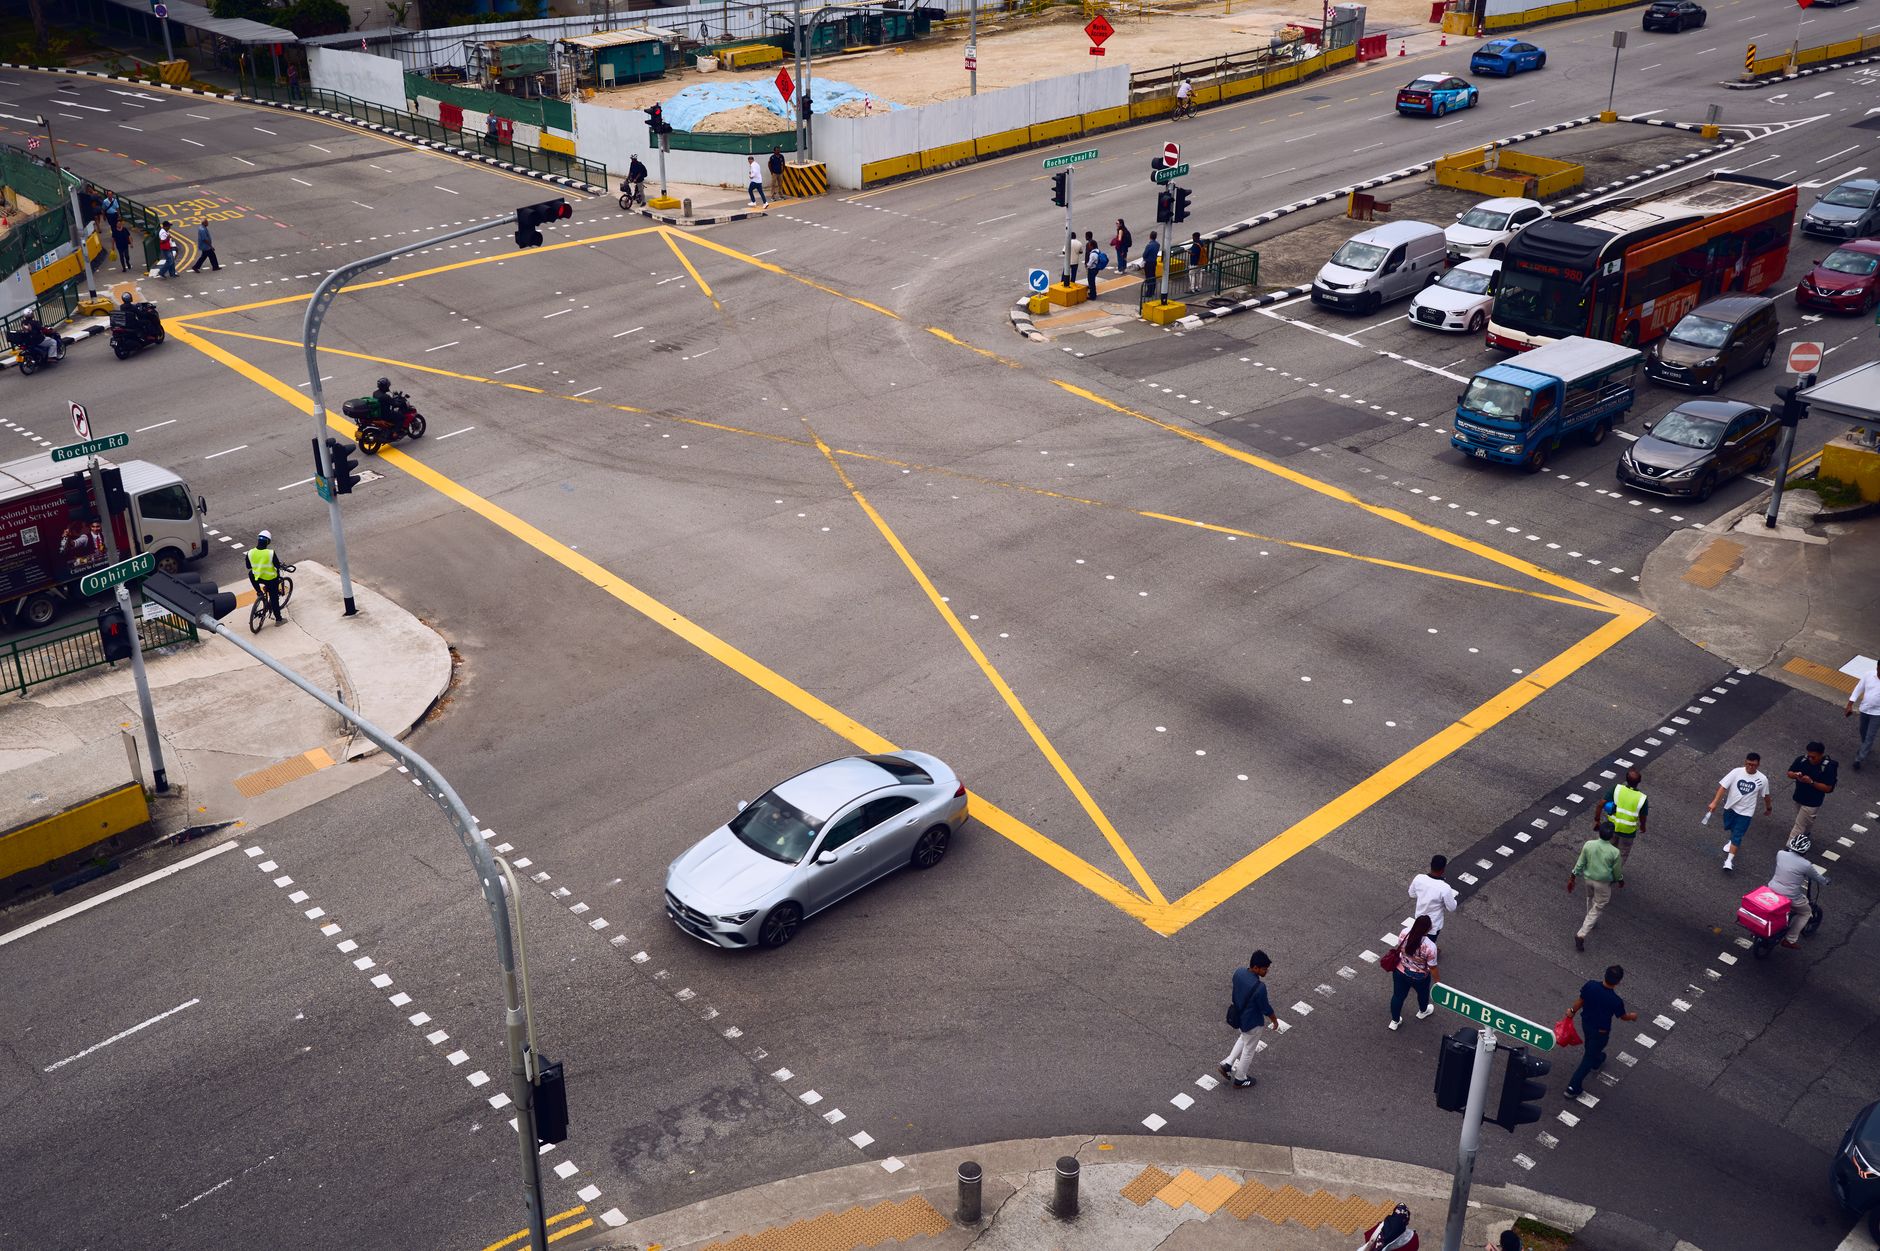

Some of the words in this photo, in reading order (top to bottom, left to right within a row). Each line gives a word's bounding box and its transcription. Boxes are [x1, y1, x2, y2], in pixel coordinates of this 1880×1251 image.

[1046, 158, 1068, 167] Rochor
[1070, 153, 1087, 163] Canal
[1089, 151, 1096, 159] Rd
[1159, 169, 1179, 179] Sungei
[1180, 165, 1187, 173] Rd
[1564, 267, 1583, 281] 980
[1650, 301, 1665, 331] ALL
[1667, 300, 1680, 324] OF
[57, 443, 102, 460] Rochor
[108, 435, 124, 448] Rd
[0, 506, 28, 520] ssional
[29, 497, 67, 512] Bartende
[8, 517, 27, 528] Your
[28, 509, 59, 522] Service
[90, 567, 127, 589] Ophir
[132, 556, 148, 573] Rd
[1441, 991, 1471, 1015] Jln
[1480, 1007, 1543, 1044] Besar
